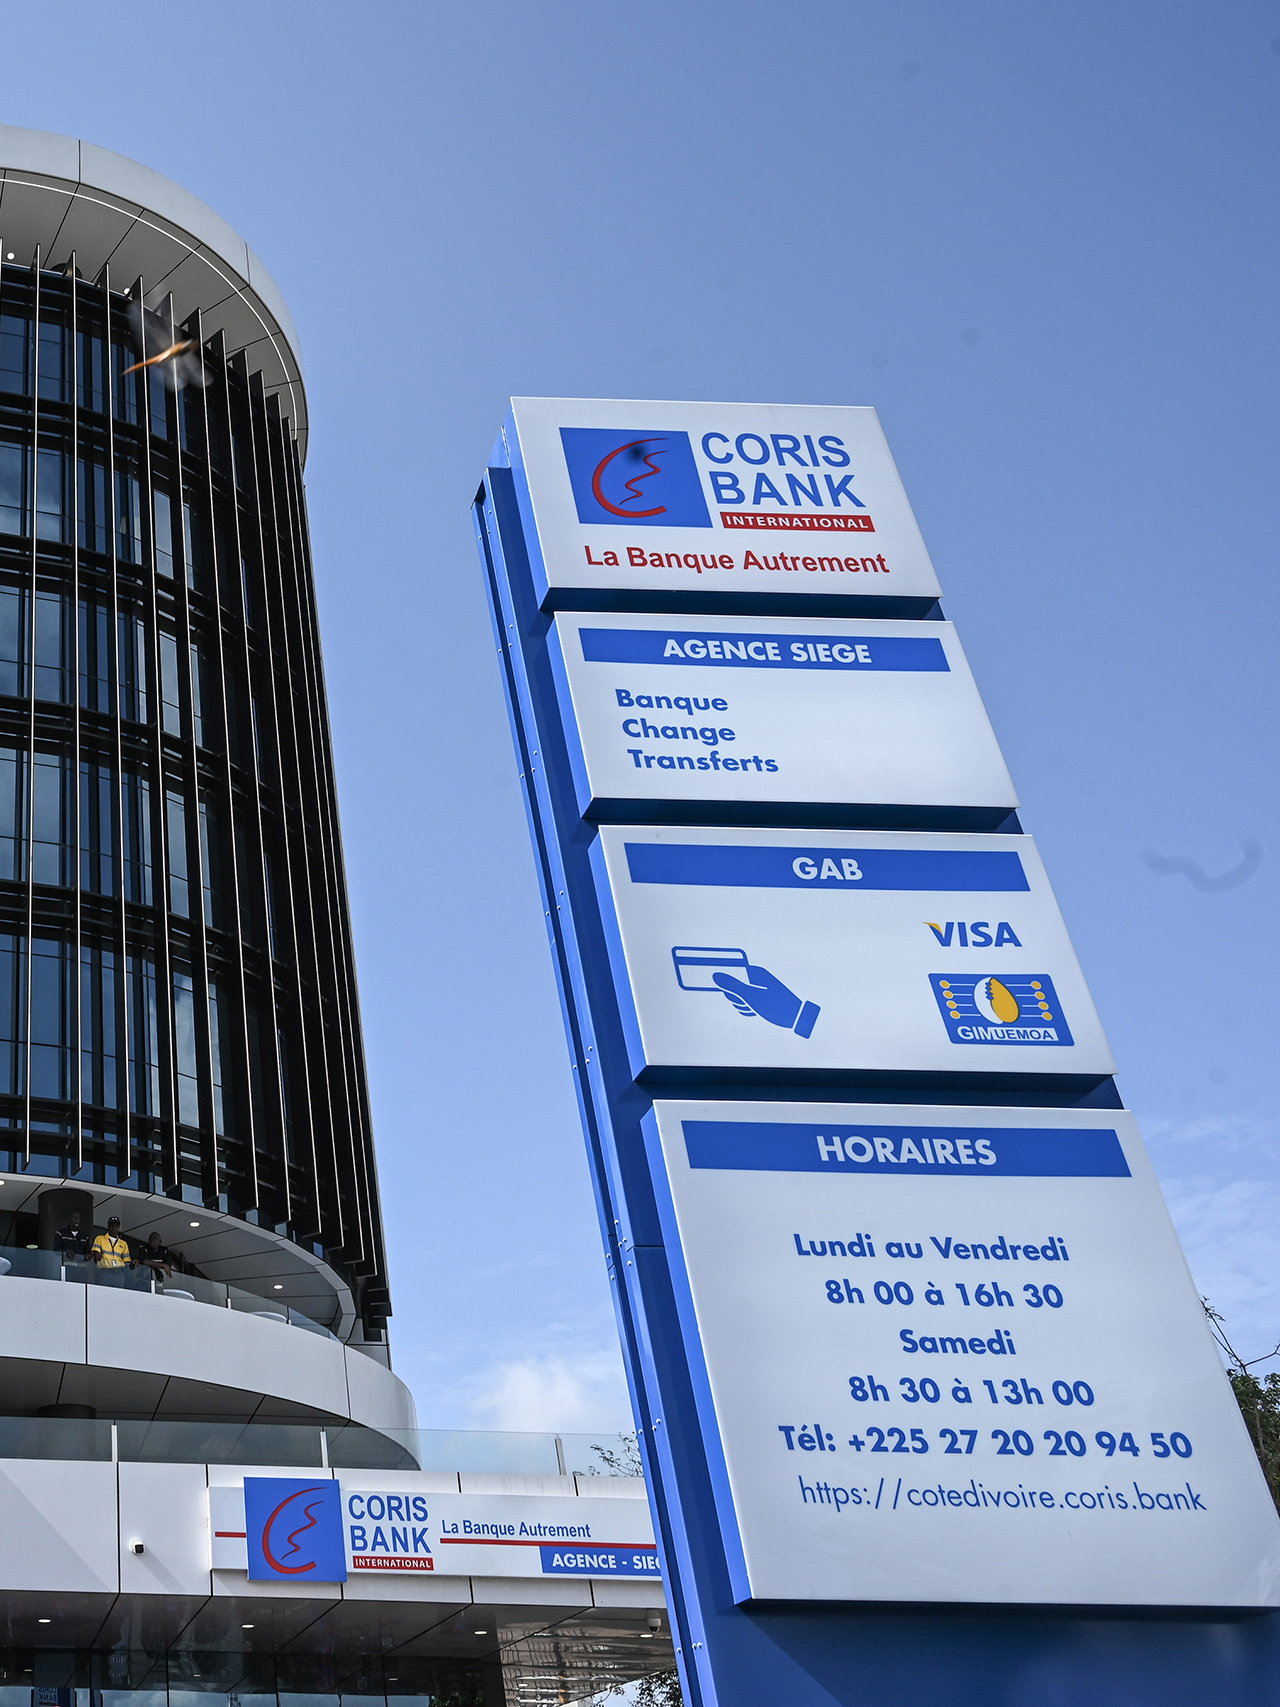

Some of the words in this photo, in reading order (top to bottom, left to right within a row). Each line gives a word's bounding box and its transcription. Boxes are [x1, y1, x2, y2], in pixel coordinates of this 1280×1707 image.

[701, 432, 851, 468] CORIS
[708, 471, 867, 508] BANK
[725, 515, 870, 529] INTERNATIONAL
[584, 545, 620, 566] La
[626, 547, 735, 574] Banque
[742, 550, 891, 573] Autrement
[662, 639, 782, 661] AGENCE
[790, 643, 873, 664] SIEGE
[615, 689, 729, 715] Banque
[621, 719, 736, 746] Change
[627, 749, 779, 773] Transferts
[792, 857, 864, 881] GAB
[922, 921, 1023, 948] VISA
[957, 1026, 1054, 1040] GIMUEMOA
[815, 1135, 998, 1166] HORAIRES
[793, 1233, 876, 1258] Lundi
[885, 1242, 923, 1259] au
[930, 1235, 1070, 1261] Vendredi
[825, 1279, 865, 1305] 8h
[873, 1281, 914, 1306] 00
[924, 1281, 946, 1306] à
[955, 1282, 1015, 1308] 16h
[1023, 1284, 1064, 1309] 30
[899, 1329, 1017, 1356] Samedi
[848, 1375, 890, 1402] 8h
[901, 1377, 941, 1403] 30
[951, 1378, 972, 1404] à
[983, 1379, 1044, 1405] 13h
[1052, 1381, 1095, 1407] 00
[778, 1424, 837, 1452] Tél:
[848, 1427, 929, 1454] +225
[939, 1429, 979, 1455] 27
[991, 1430, 1035, 1456] 20
[1043, 1431, 1087, 1457] 20
[1095, 1432, 1140, 1457] 94
[1151, 1432, 1193, 1459] 50
[798, 1475, 1208, 1512] https://cotedivoire.coris.bank
[348, 1494, 429, 1522] CORIS
[350, 1525, 432, 1554] BANK
[441, 1519, 459, 1534] La
[463, 1520, 515, 1539] Banque
[519, 1522, 591, 1538] Autrement
[355, 1559, 431, 1569] INTERNATIONAL
[552, 1553, 617, 1569] AGENCE
